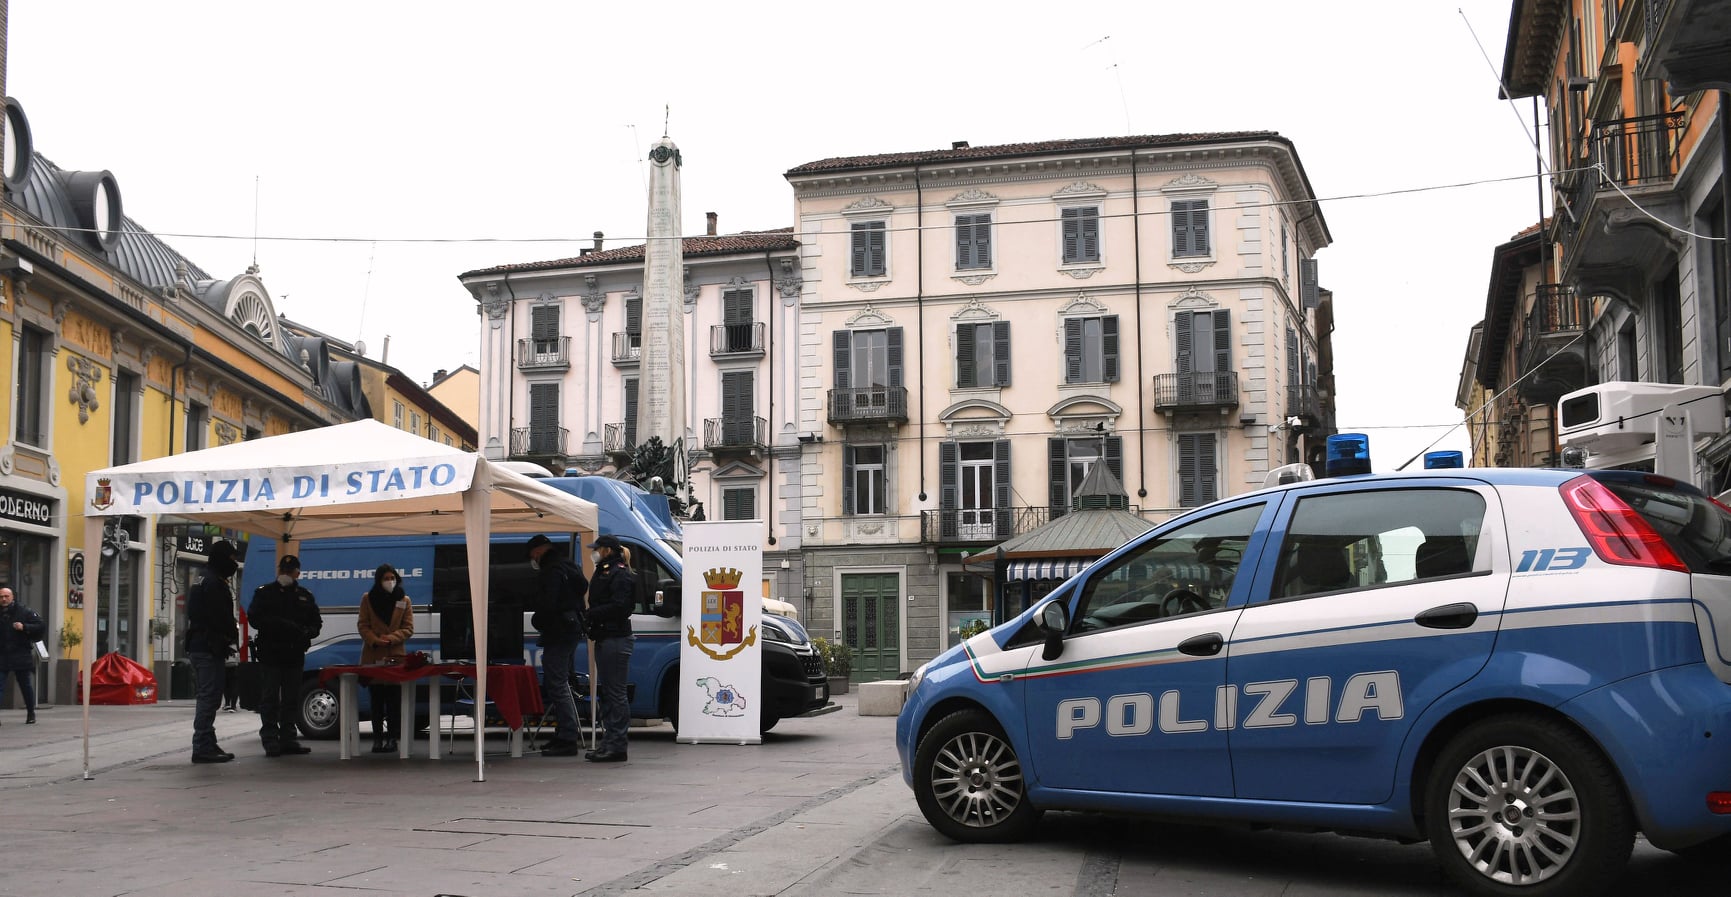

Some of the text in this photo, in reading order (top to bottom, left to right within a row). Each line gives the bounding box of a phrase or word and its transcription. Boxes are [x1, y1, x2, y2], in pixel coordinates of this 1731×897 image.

[133, 463, 456, 506] POLIZIA DI STATO
[0, 495, 49, 522] ODERNO
[185, 536, 204, 552] Juice
[1515, 547, 1593, 573] 113
[298, 568, 423, 580] FFICIO MOLE
[1055, 669, 1405, 740] POLIZIA
